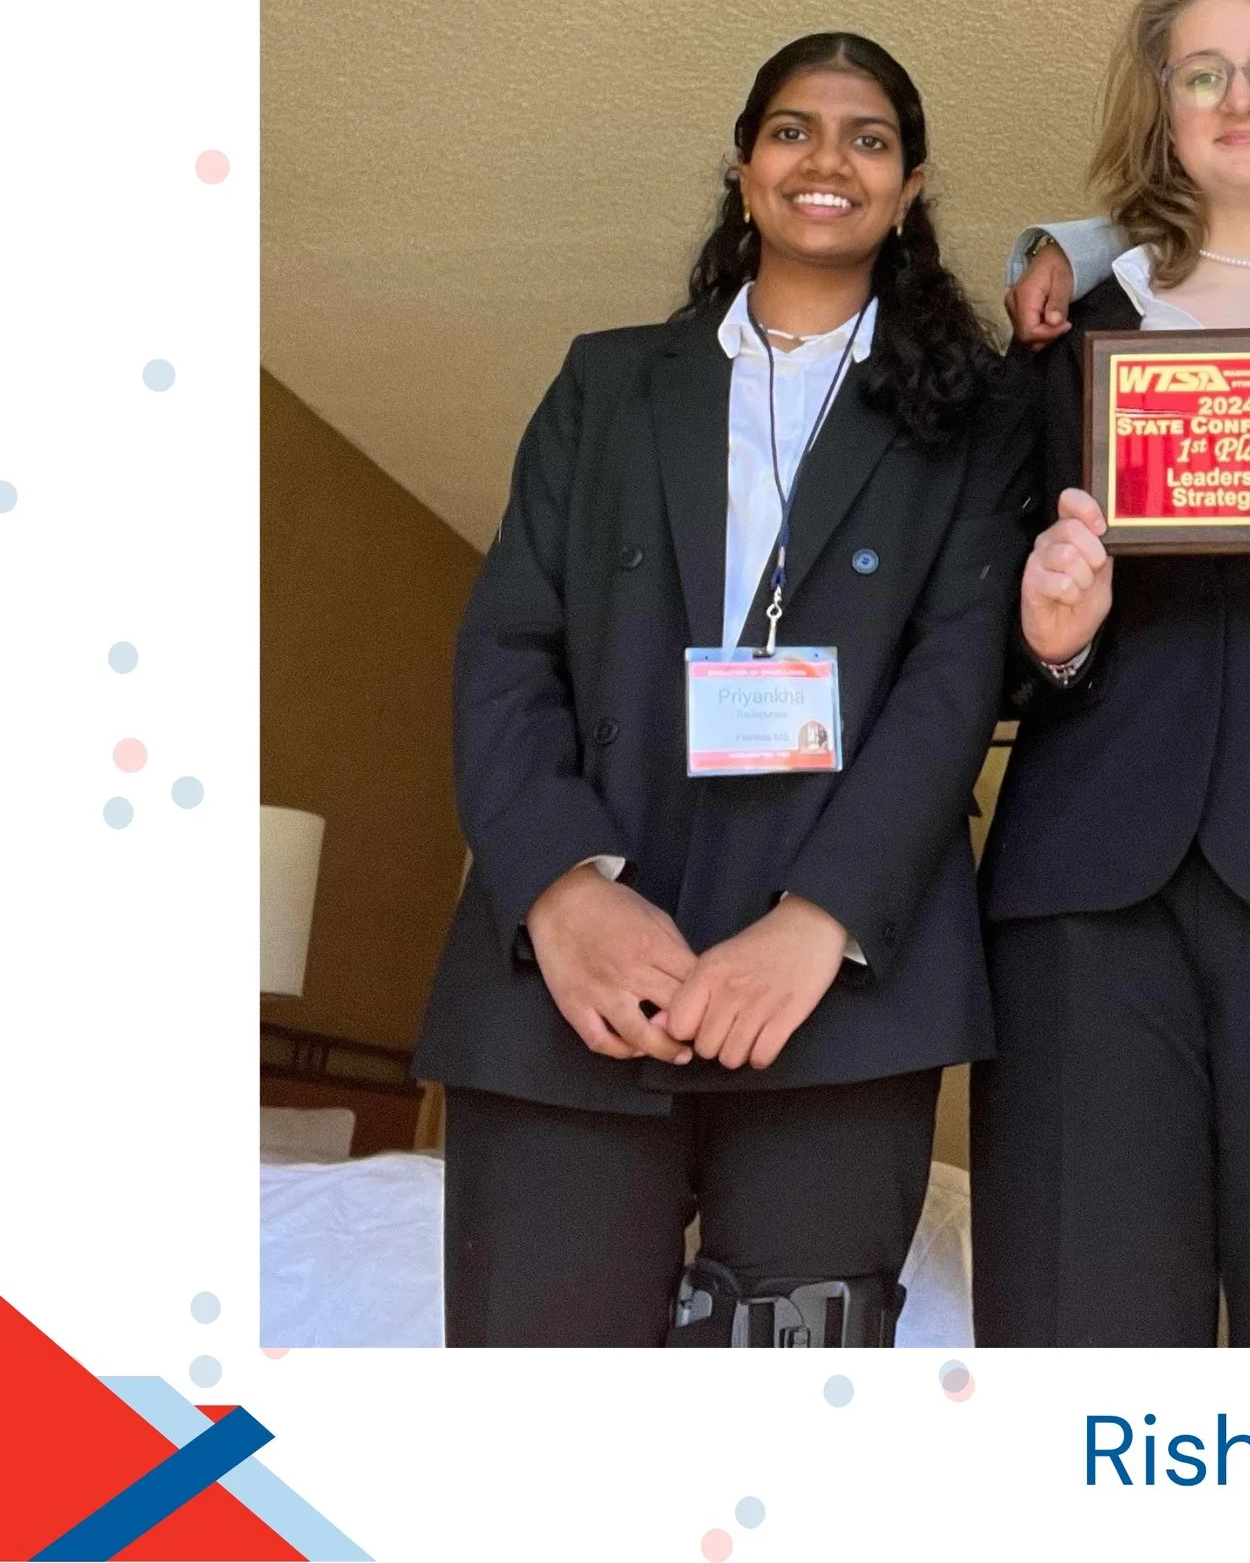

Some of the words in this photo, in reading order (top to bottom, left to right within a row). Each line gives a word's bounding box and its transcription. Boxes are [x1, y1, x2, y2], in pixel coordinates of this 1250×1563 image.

[1119, 365, 1230, 393] WTSA
[1177, 437, 1207, 462] 1st
[718, 688, 805, 707] Priyankha
